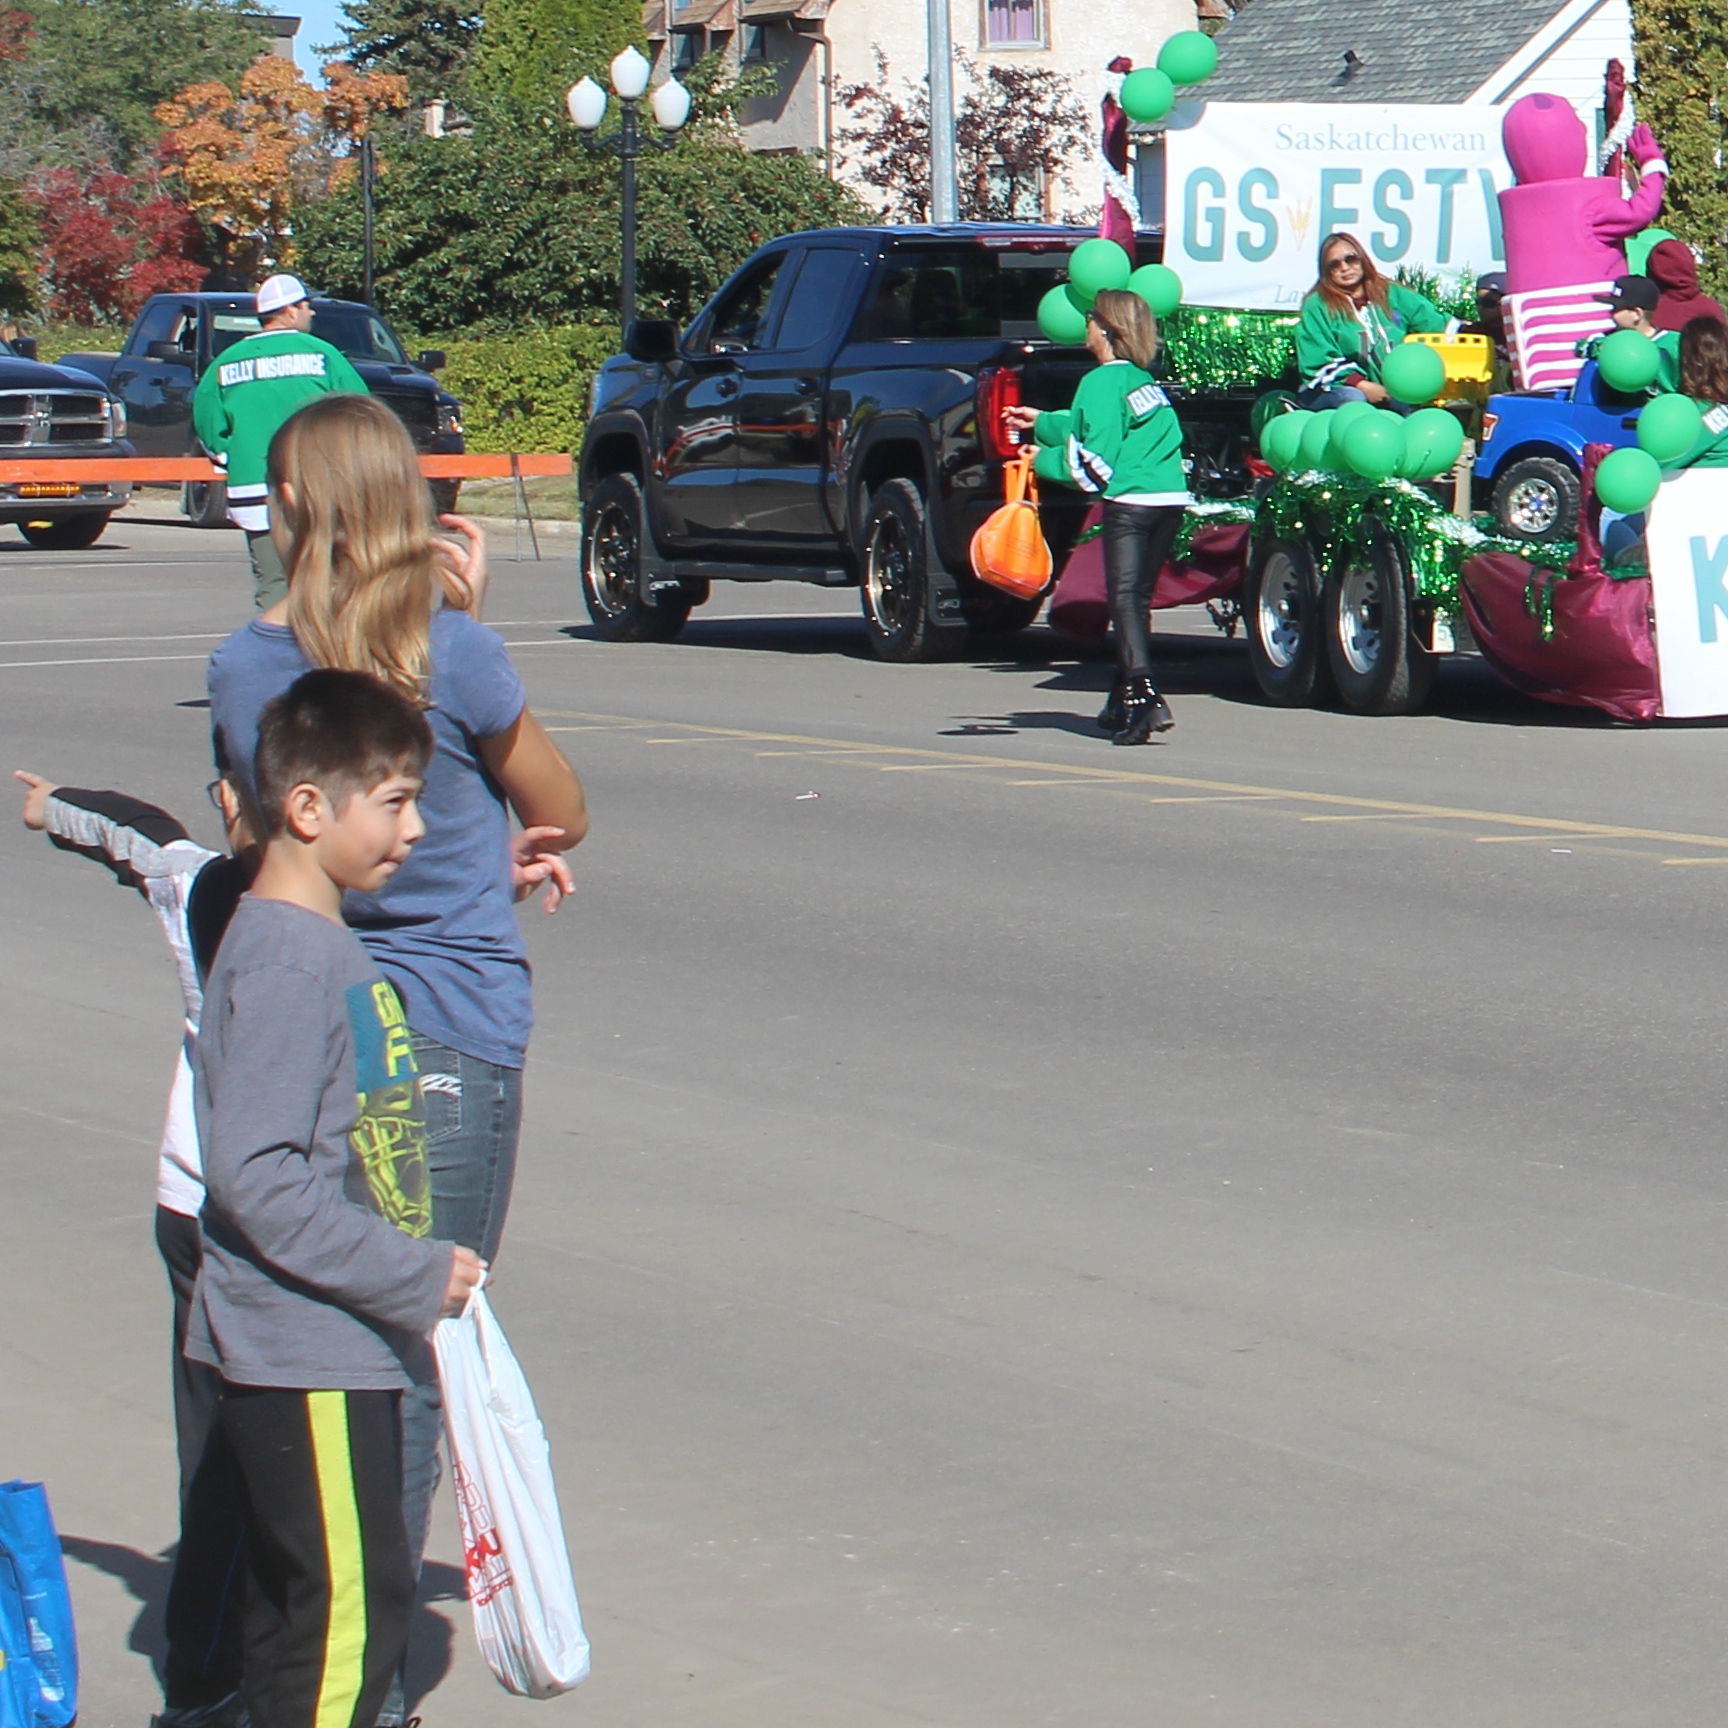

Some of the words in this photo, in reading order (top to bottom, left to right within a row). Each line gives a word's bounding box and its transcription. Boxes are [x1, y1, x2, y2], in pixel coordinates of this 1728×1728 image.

[1275, 122, 1487, 152] Saskatchewan
[1183, 167, 1279, 263] GS
[219, 358, 254, 387] KELLY
[256, 353, 325, 379] INSURANCE
